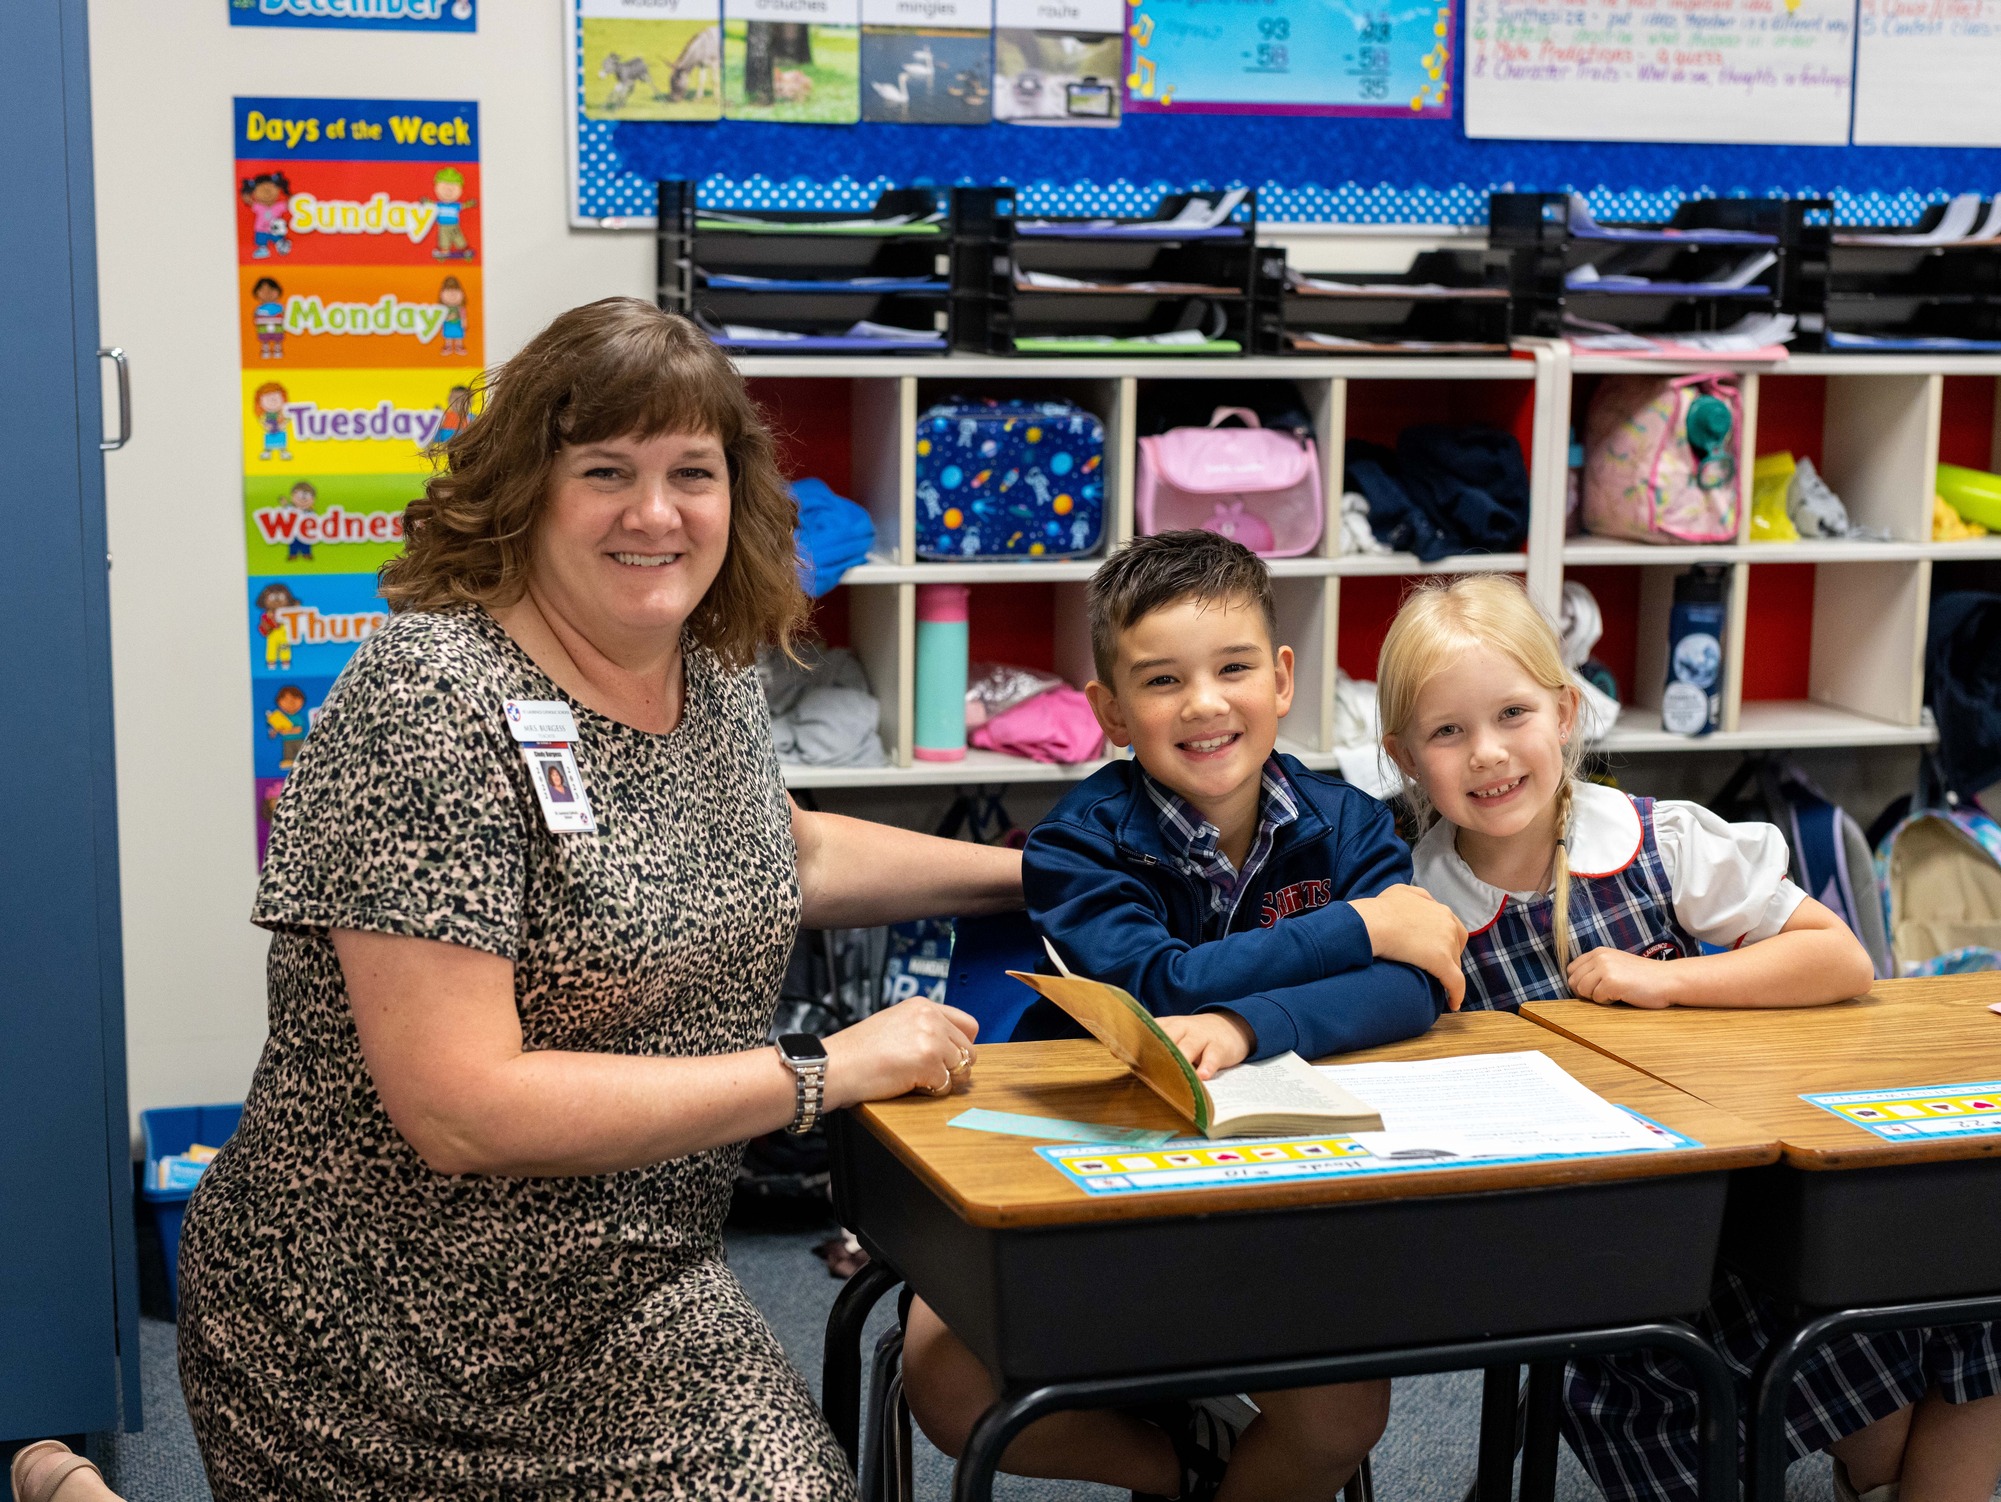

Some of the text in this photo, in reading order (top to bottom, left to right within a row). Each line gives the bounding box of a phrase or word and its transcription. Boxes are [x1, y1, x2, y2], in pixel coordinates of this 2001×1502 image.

[897, 1, 957, 18] mingles
[1257, 16, 1290, 40] 93
[247, 110, 471, 149] Days of the Week
[292, 196, 435, 239] Sunday
[286, 299, 443, 338] Monday
[286, 404, 441, 443] Tuesday
[258, 509, 404, 540] Wednes
[280, 611, 385, 641] Thurs
[539, 724, 567, 732] BURGESS
